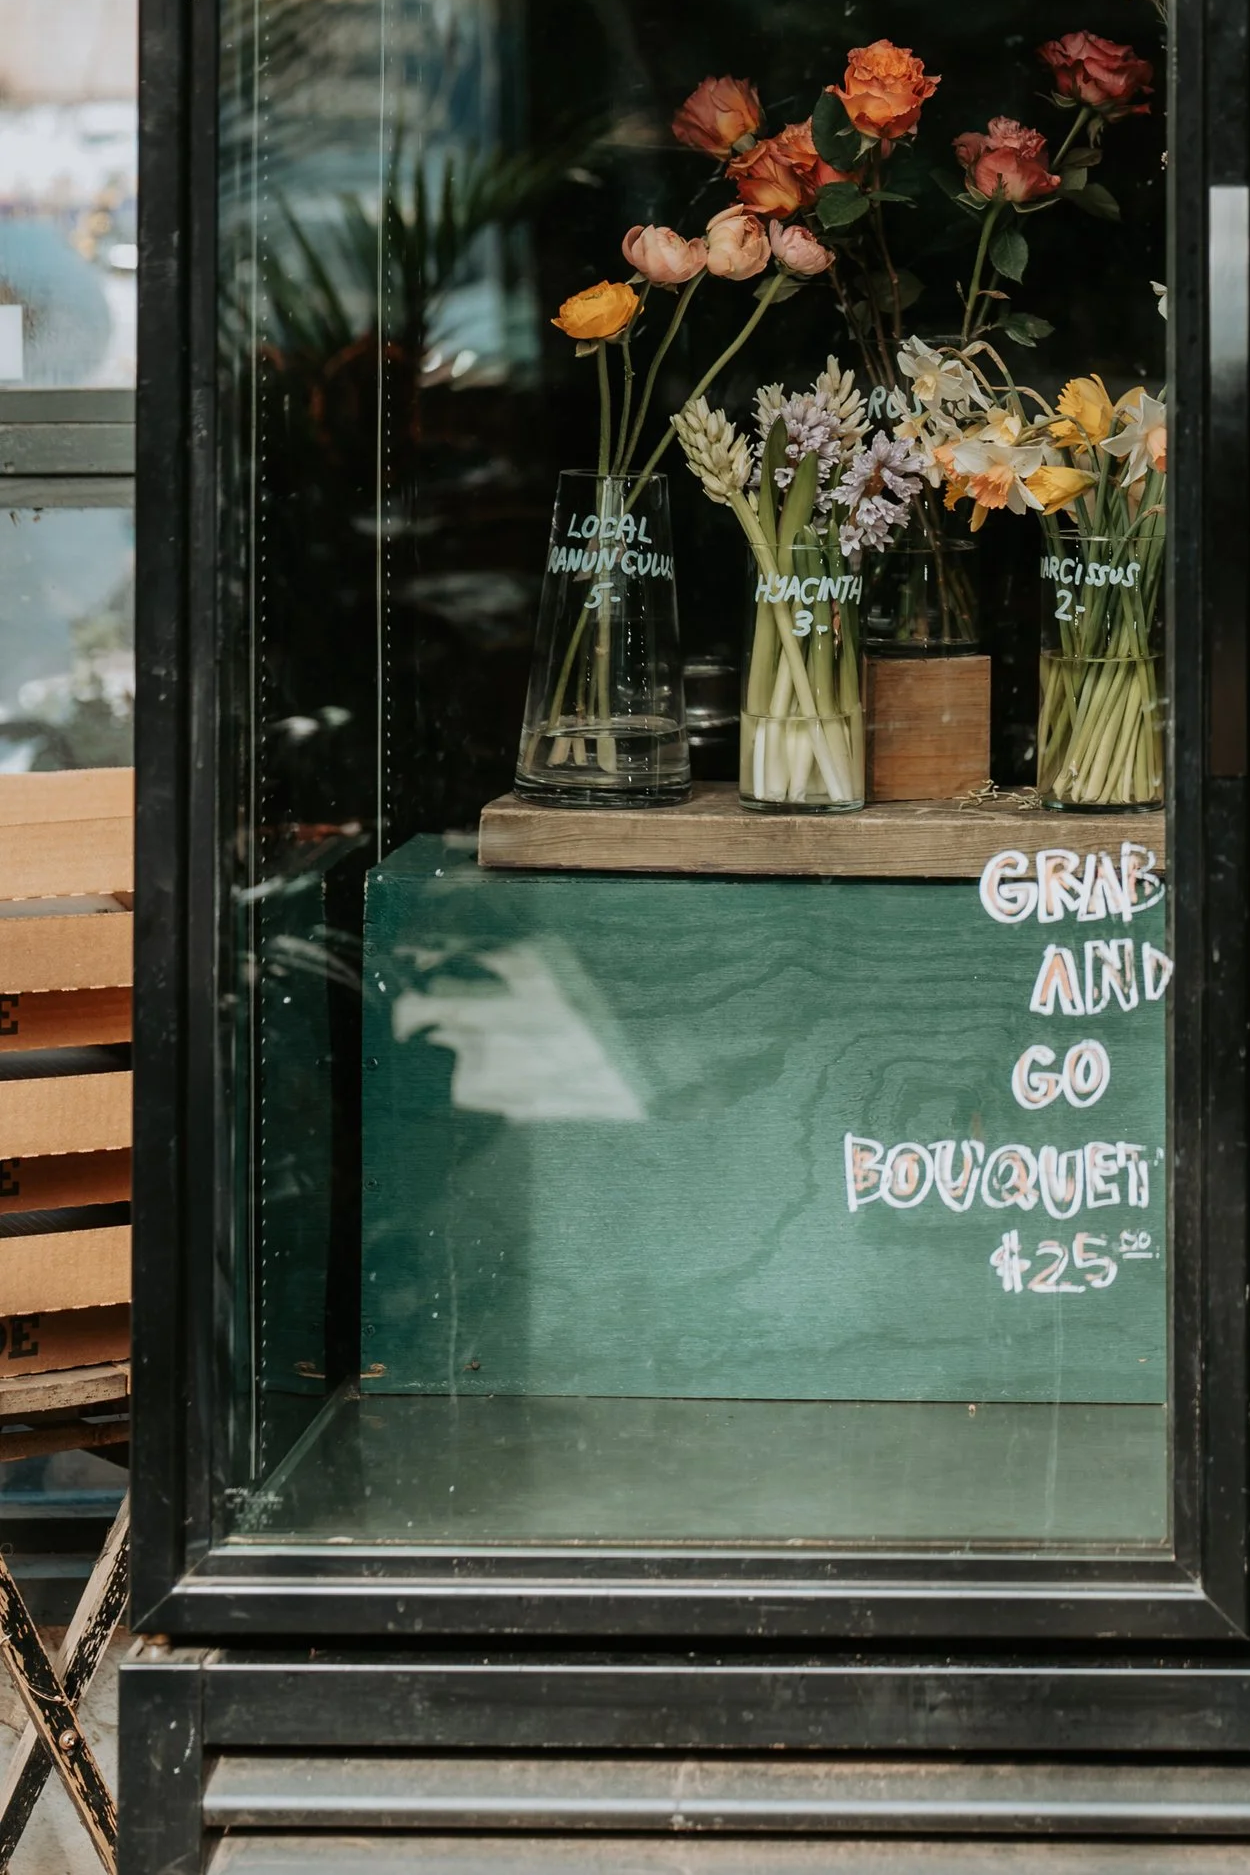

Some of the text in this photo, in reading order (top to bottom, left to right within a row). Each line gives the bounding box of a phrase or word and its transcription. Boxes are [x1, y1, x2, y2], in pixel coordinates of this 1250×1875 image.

[567, 513, 653, 544] LOCAL
[754, 571, 863, 605] HYACINTH
[978, 841, 1166, 924] GRAB
[1029, 937, 1175, 1016] AND
[1011, 1039, 1112, 1111] GO
[843, 1131, 1151, 1220] BOUQUET
